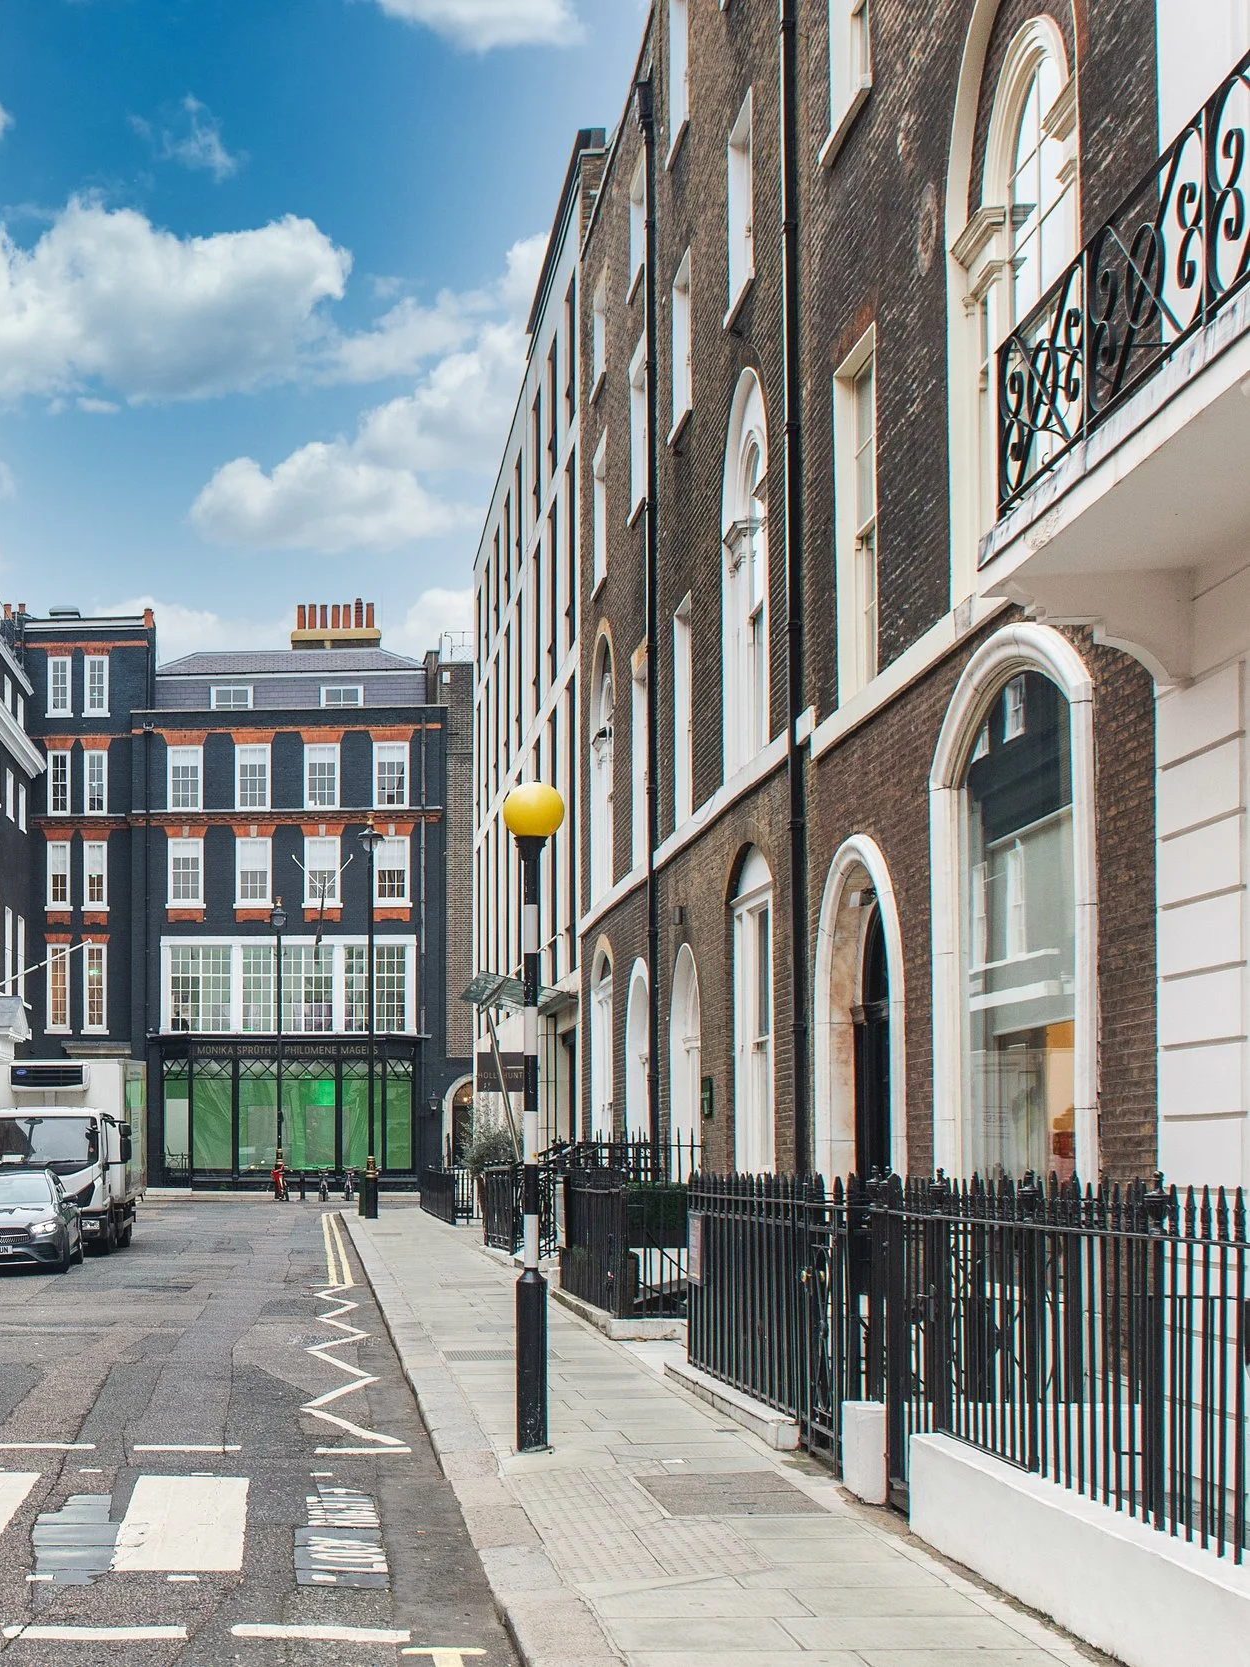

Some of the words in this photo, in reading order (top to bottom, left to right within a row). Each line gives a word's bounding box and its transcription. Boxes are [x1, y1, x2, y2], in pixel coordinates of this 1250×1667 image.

[197, 1046, 233, 1055] MONIKA
[284, 1045, 337, 1055] PHILOMENE
[340, 1045, 378, 1055] MAGES
